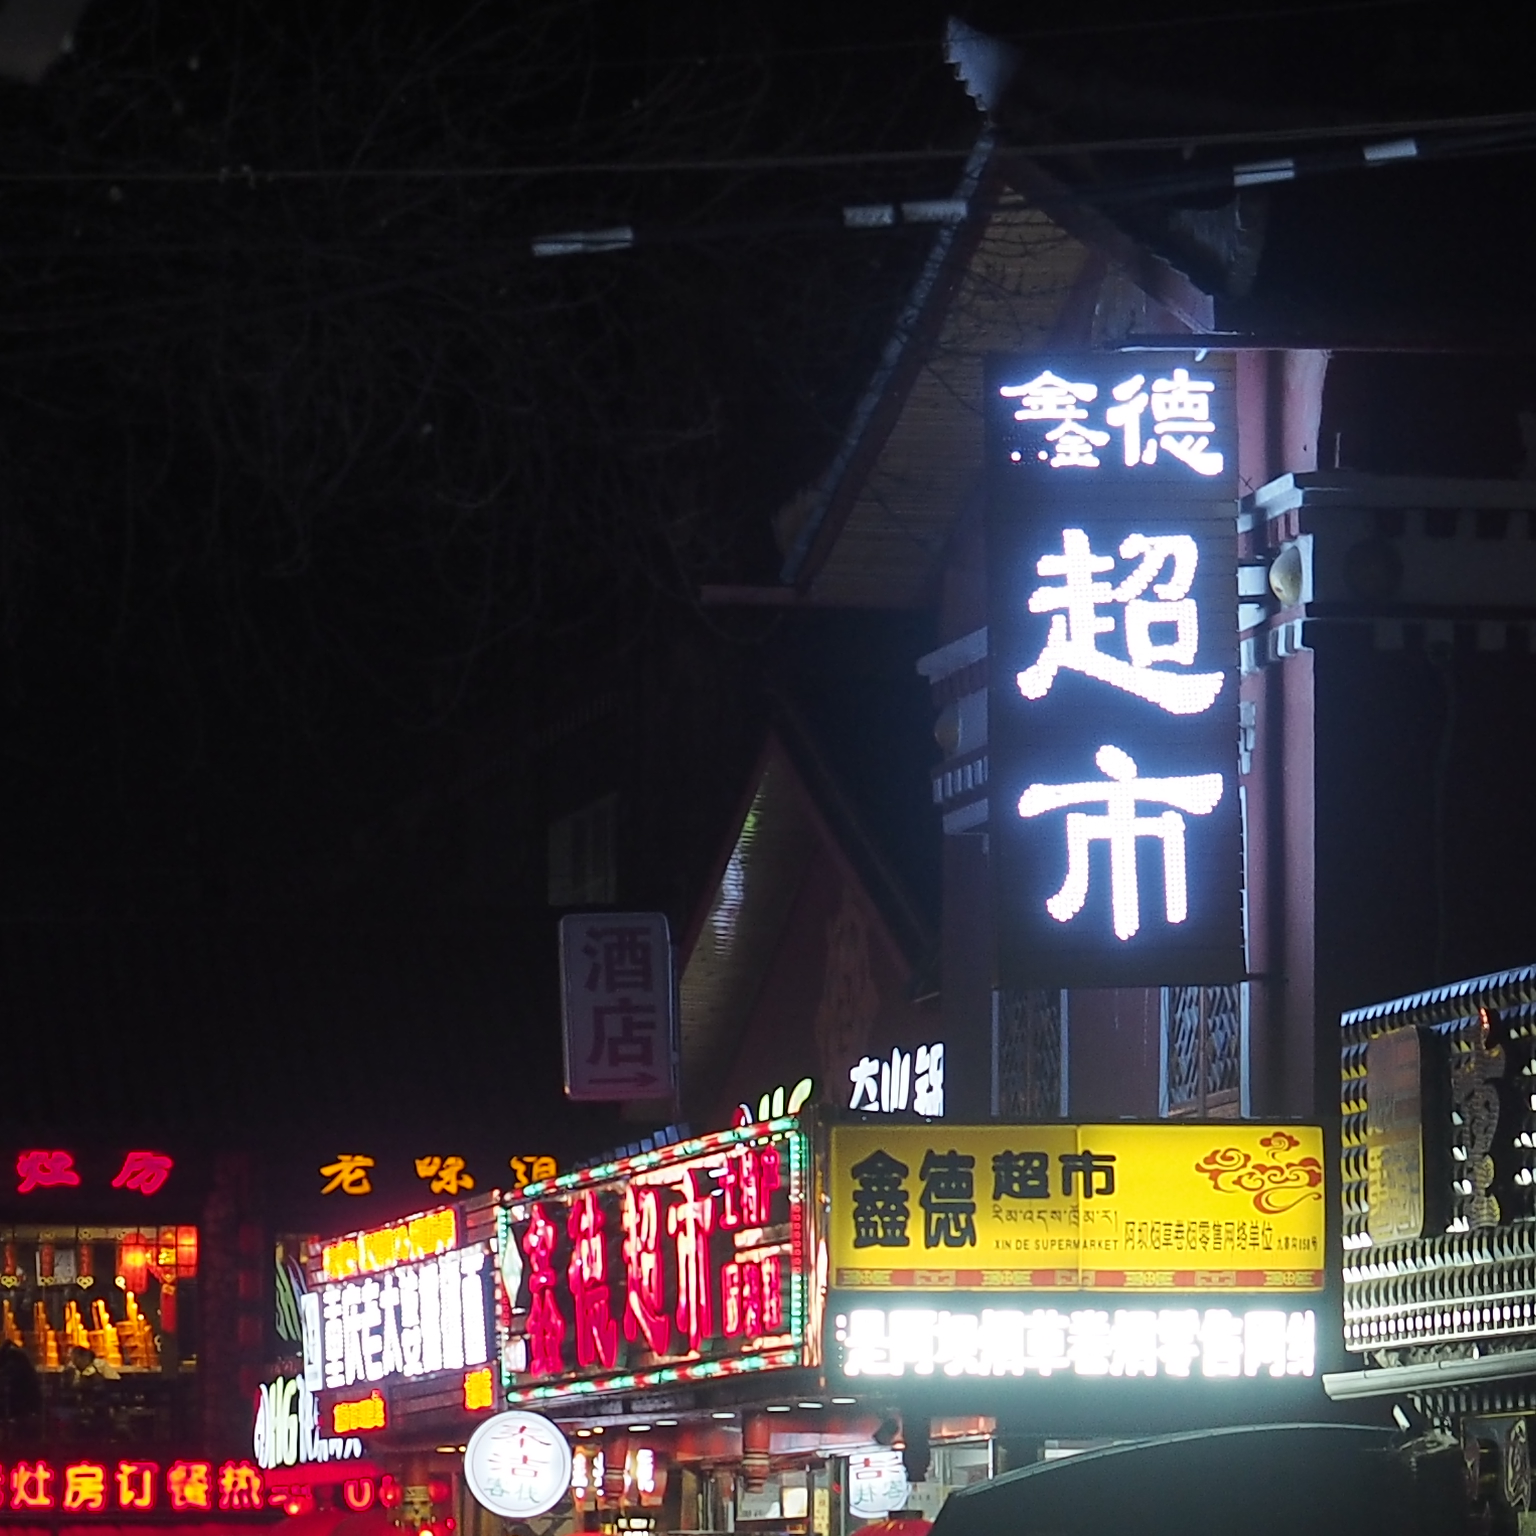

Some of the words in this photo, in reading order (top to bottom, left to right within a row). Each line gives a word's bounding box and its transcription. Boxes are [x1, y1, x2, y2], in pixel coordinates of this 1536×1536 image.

[582, 926, 656, 1068] 酒店
[850, 1149, 1118, 1250] 鑫德超市
[994, 1239, 1012, 1251] XIN
[1015, 1239, 1029, 1251] DE
[1034, 1239, 1120, 1251] SUPERMARKET
[525, 1168, 716, 1379] 鑫德超市
